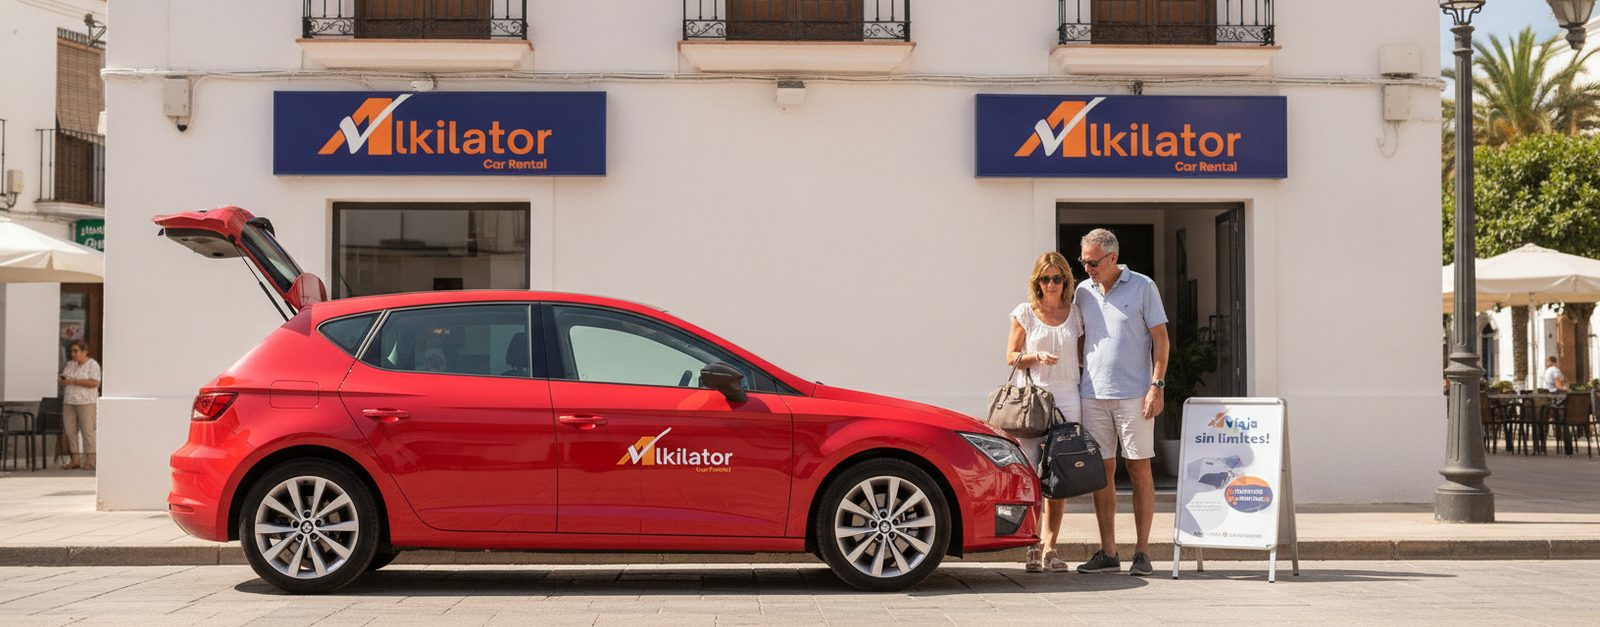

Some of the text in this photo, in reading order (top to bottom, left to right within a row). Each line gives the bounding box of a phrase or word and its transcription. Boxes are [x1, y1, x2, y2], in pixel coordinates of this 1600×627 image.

[483, 158, 547, 169] Car Rental
[1175, 161, 1237, 172] Car Rental
[1194, 433, 1215, 444] sin
